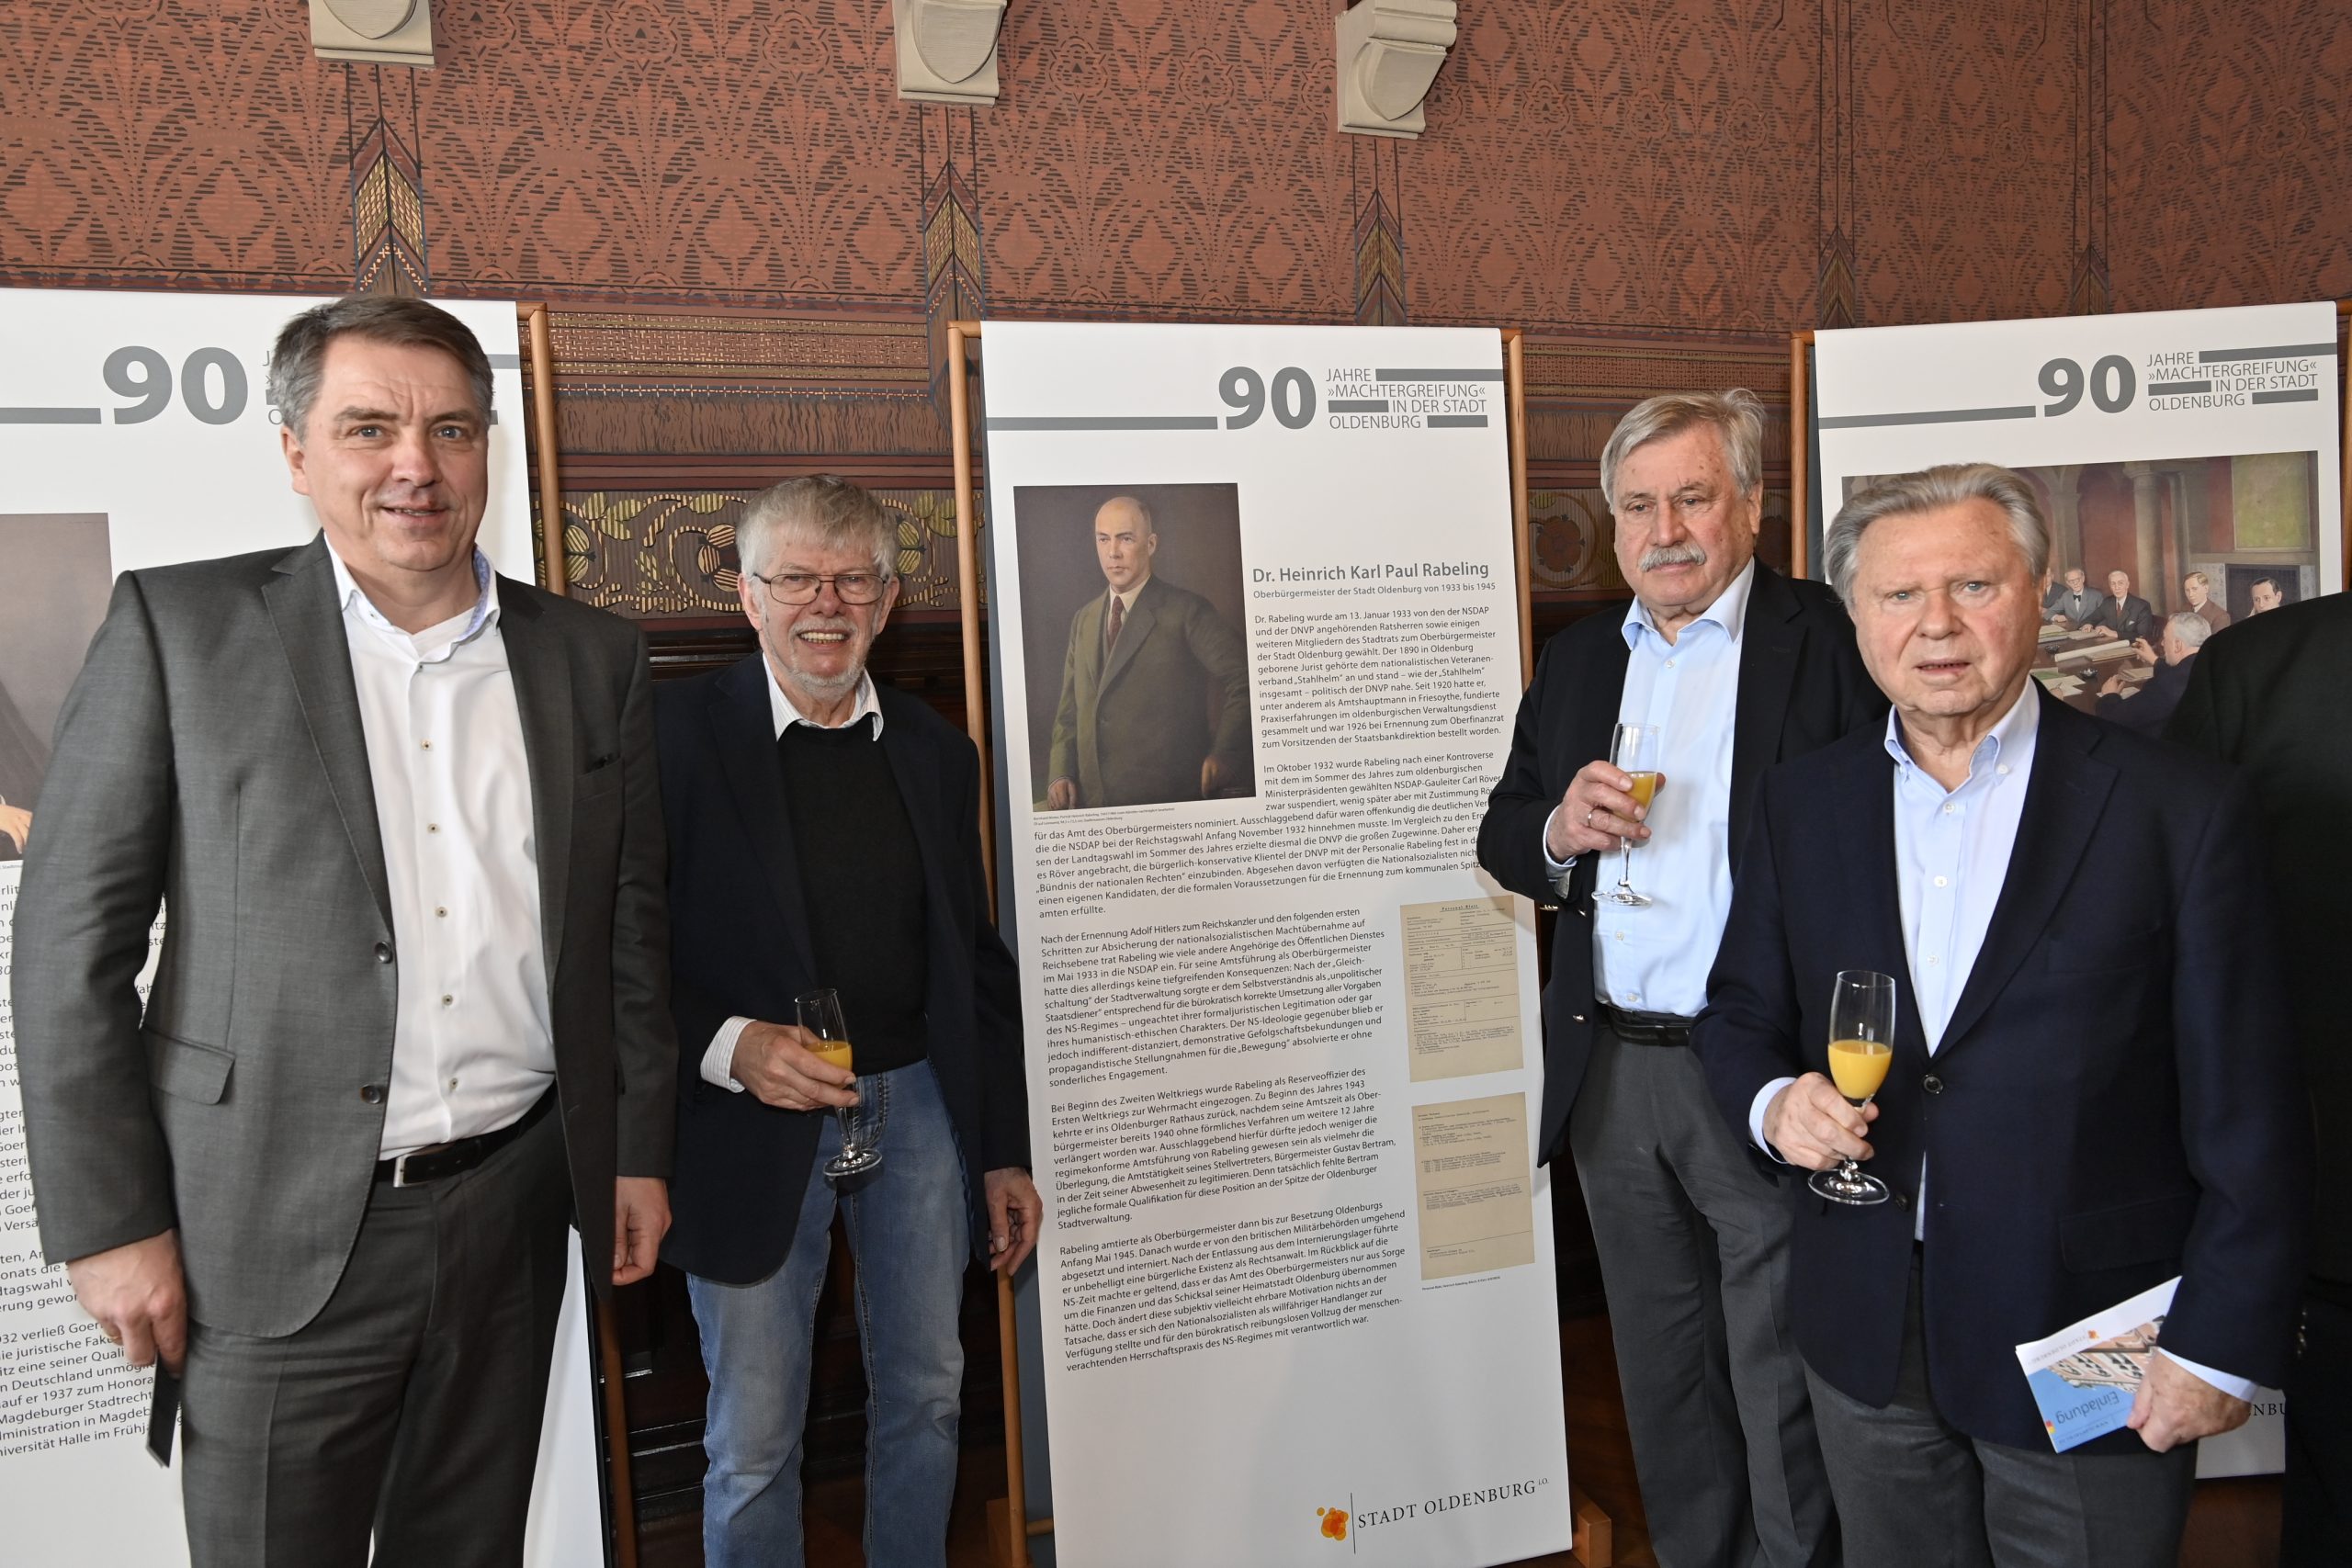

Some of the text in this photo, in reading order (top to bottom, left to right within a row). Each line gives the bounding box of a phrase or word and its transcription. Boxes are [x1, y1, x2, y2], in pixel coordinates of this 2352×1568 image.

[2146, 351, 2194, 367] JAHRE
[103, 345, 248, 424] 90
[1326, 368, 1371, 382] JAHRE
[2215, 373, 2318, 393] IN DER STADT
[2038, 355, 2137, 417] 90
[1218, 366, 1316, 430] 90
[1393, 399, 1487, 413] IN DER STADT
[2149, 393, 2245, 412] OLDENBURG
[1329, 415, 1420, 429] OLDENBURG
[1252, 560, 1488, 582] Dr. Heinrich Karl Paul Rabeling
[1253, 588, 1335, 599] Oberbürgermeister
[1337, 587, 1351, 595] der
[1352, 586, 1375, 594] Stadt
[1377, 584, 1421, 593] Oldenburg
[1476, 581, 1495, 590] 1945
[1254, 615, 1266, 623] Dr.
[1268, 614, 1305, 623] Rabeling
[1306, 612, 1332, 621] wurde
[1350, 611, 1361, 619] 13.
[1363, 611, 1389, 619] Januar
[1392, 609, 1411, 617] 1933
[1430, 607, 1445, 615] den
[1446, 607, 1460, 615] der
[1462, 606, 1489, 615] NSDAP
[1255, 619, 1479, 636] und der DNVP angehörenden Ratsherren sowie einigen
[1255, 639, 1293, 648] weiteren
[1295, 637, 1343, 648] Mitgliedern
[1345, 636, 1360, 644] des
[1362, 635, 1398, 643] Stadtrats
[1419, 630, 1495, 641] Oberbürgermeister
[1257, 652, 1271, 660] der
[1272, 650, 1295, 660] Stadt
[1297, 649, 1342, 659] Oldenburg
[1344, 647, 1380, 659] gewählt.
[1382, 647, 1396, 655] Der
[1399, 646, 1419, 654] 1890
[1430, 643, 1473, 652] Oldenburg
[1257, 664, 1298, 675] geborene
[1300, 662, 1323, 671] Jurist
[1325, 661, 1358, 671] gehörte
[1360, 660, 1378, 668] dem
[1380, 656, 1449, 667] nationalistischen
[1276, 762, 1311, 772] Oktober
[1313, 761, 1333, 770] 1932
[1335, 759, 1362, 768] wurde
[1363, 757, 1400, 766] Rabeling
[1402, 755, 1421, 763] nach
[1423, 754, 1444, 762] einer
[1446, 751, 1493, 761] Kontroverse
[1039, 905, 1105, 918] amten erfüllte.
[1040, 934, 1063, 943] Nach
[1064, 933, 1080, 942] der
[1080, 930, 1127, 941] Ernennung
[1129, 926, 1152, 935] Adolf
[1154, 924, 1181, 933] Hitlers
[1202, 917, 1257, 930] Reichskanzler
[1258, 914, 1274, 924] und
[1275, 914, 1292, 922] den
[1293, 909, 1333, 921] folgenden
[1335, 908, 1360, 917] ersten
[1050, 1067, 1365, 1112] Bei Beginn des Zweiten Weltkriegs wurde Rabeling als Reserveoffizier des
[1059, 1201, 1383, 1255] Rabeling amtierte als Oberbürgermeister dann bis zur Besetzung Oldenburgs
[22, 1325, 65, 1341] verließ
[17, 1340, 82, 1360] juristische
[1066, 1315, 1368, 1371] verachtenden Herrschaftspraxis des NS-Regimes mit verantwortlich war.
[18, 1362, 46, 1373] eine
[50, 1355, 88, 1369] seiner
[12, 1369, 93, 1391] Deutschland
[26, 1395, 39, 1404] er
[43, 1387, 74, 1402] 1937
[77, 1384, 104, 1396] zum
[2055, 1391, 2120, 1424] Einladung
[85, 1416, 96, 1427] in
[59, 1433, 91, 1447] Halle
[94, 1431, 110, 1440] im
[1358, 1504, 1417, 1529] STADT
[1424, 1480, 1536, 1515] OLDENBURG
